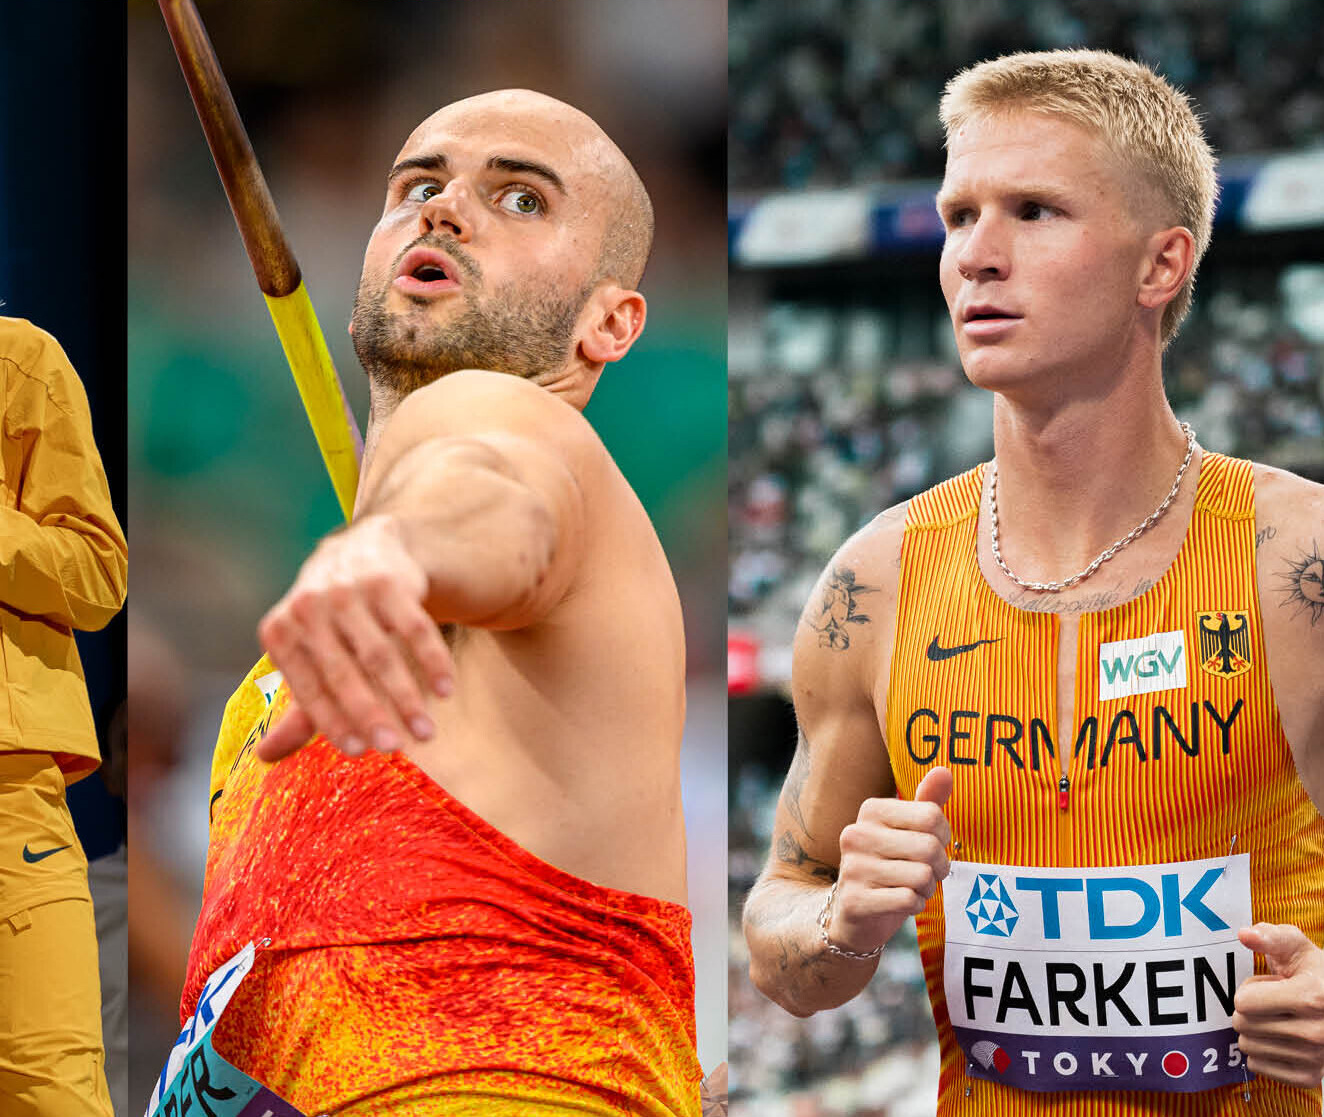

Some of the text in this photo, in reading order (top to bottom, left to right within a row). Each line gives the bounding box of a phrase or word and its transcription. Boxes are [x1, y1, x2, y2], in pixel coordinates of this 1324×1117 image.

[1101, 645, 1183, 684] WGV
[905, 698, 1244, 772] GERMANY
[1015, 867, 1231, 941] TDK
[963, 951, 1237, 1027] FARKEN
